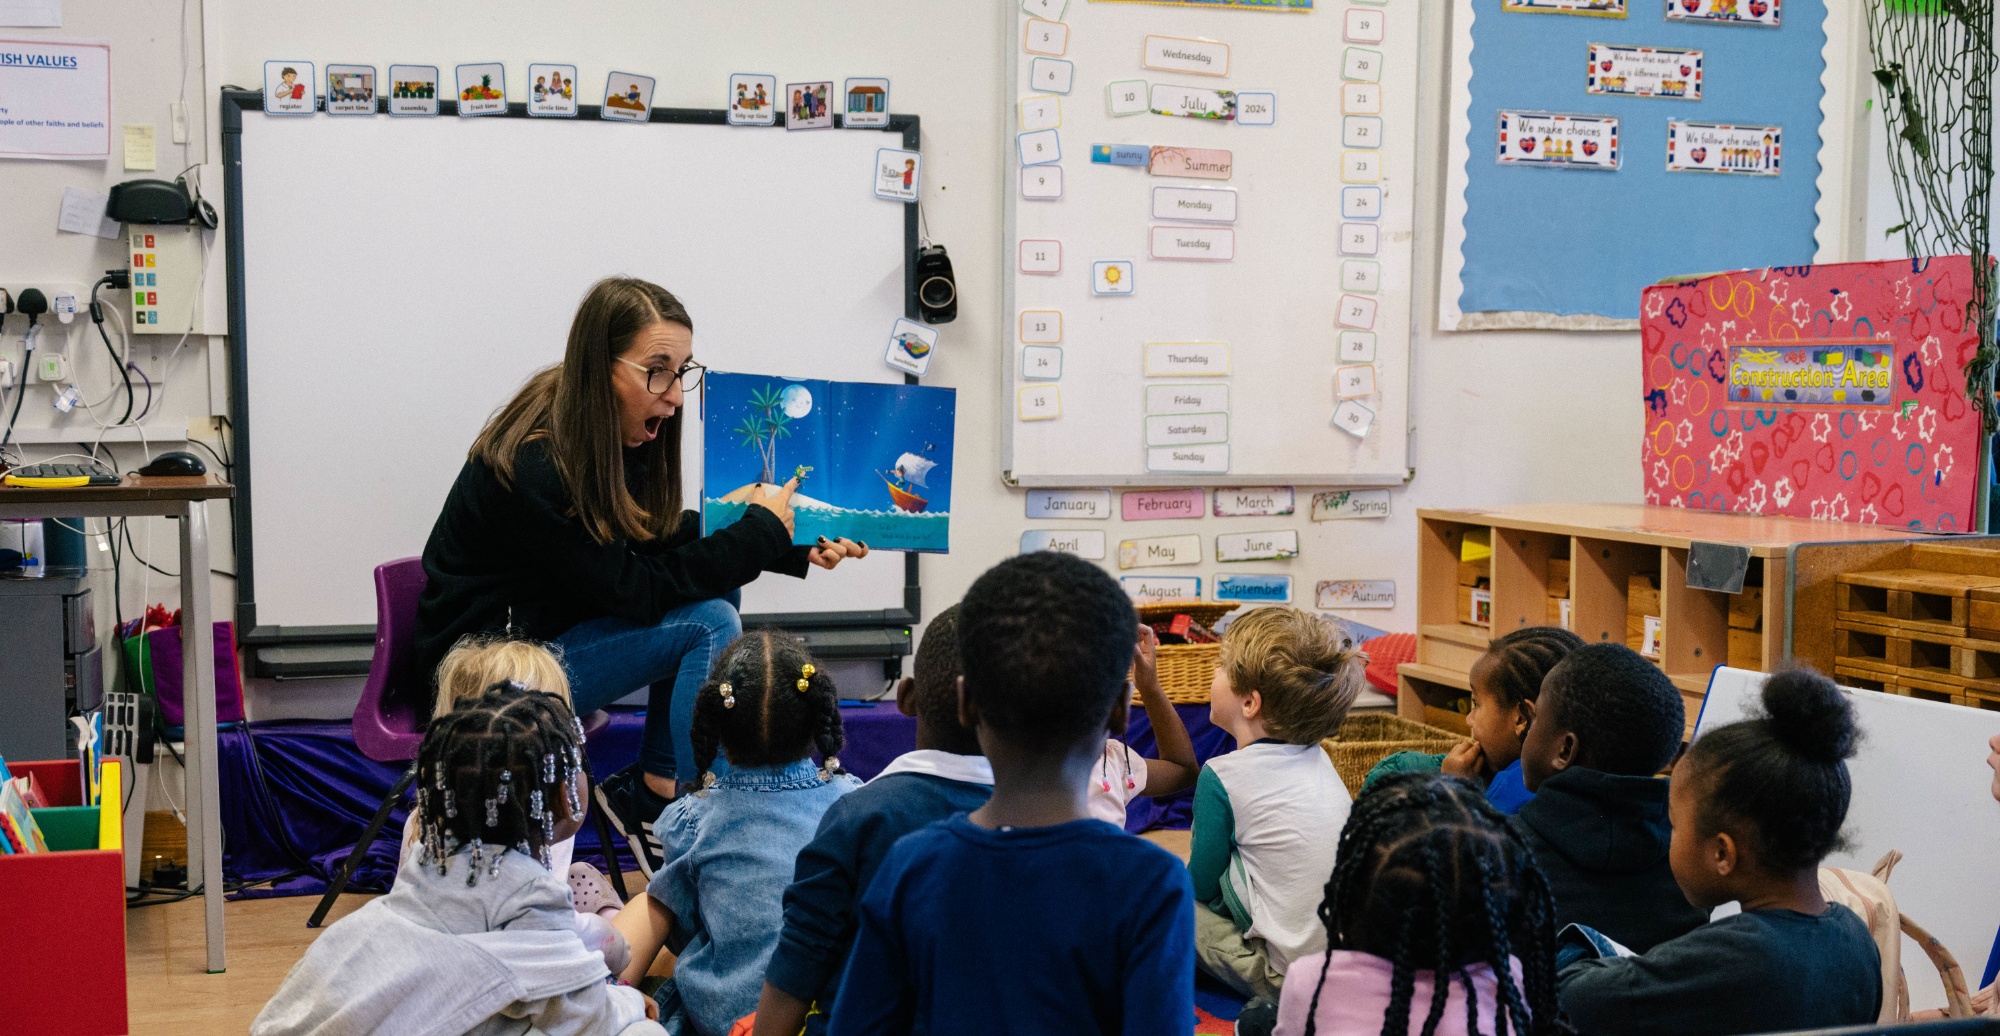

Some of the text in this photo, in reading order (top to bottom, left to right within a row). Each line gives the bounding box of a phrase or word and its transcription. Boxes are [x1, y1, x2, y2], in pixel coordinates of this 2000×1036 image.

[1360, 20, 1370, 30] 19
[1043, 32, 1050, 42] 5
[26, 54, 78, 67] VALUES
[1162, 48, 1212, 65] Wednesday
[1613, 52, 1623, 61] We
[1642, 56, 1655, 64] that
[1657, 57, 1671, 65] each
[1357, 60, 1369, 70] 20
[1048, 72, 1055, 80] 6
[1634, 70, 1659, 79] different
[1124, 92, 1267, 114] 10 July 2024
[1356, 94, 1367, 102] 21
[1037, 108, 1044, 118] 7
[1357, 128, 1369, 136] 22
[1519, 118, 1600, 137] We make choices
[1686, 131, 1761, 148] We follow the rules
[1036, 142, 1043, 152] 8
[1115, 149, 1231, 172] sunny Summer
[1356, 162, 1368, 170] 23
[1038, 176, 1045, 186] 9
[1177, 199, 1213, 212] Monday
[1356, 198, 1368, 208] 24
[1353, 234, 1365, 244] 25
[1175, 238, 1211, 251] Tuesday
[1035, 252, 1046, 260] 11
[1355, 272, 1367, 280] 26
[1351, 308, 1363, 316] 27
[1035, 322, 1047, 332] 13
[1352, 342, 1363, 352] 28
[1037, 358, 1049, 366] 14
[1167, 354, 1209, 366] Thursday
[1731, 358, 1888, 388] Construction Area
[1350, 376, 1361, 386] 29
[1034, 398, 1046, 406] 15
[1174, 395, 1202, 407] Friday
[1347, 412, 1360, 424] 30
[1167, 424, 1207, 436] Saturday
[1172, 451, 1205, 464] Sunday
[1044, 496, 1389, 515] January February March Spring
[1048, 538, 1273, 562] April May June
[1138, 581, 1394, 603] August September Autumn
